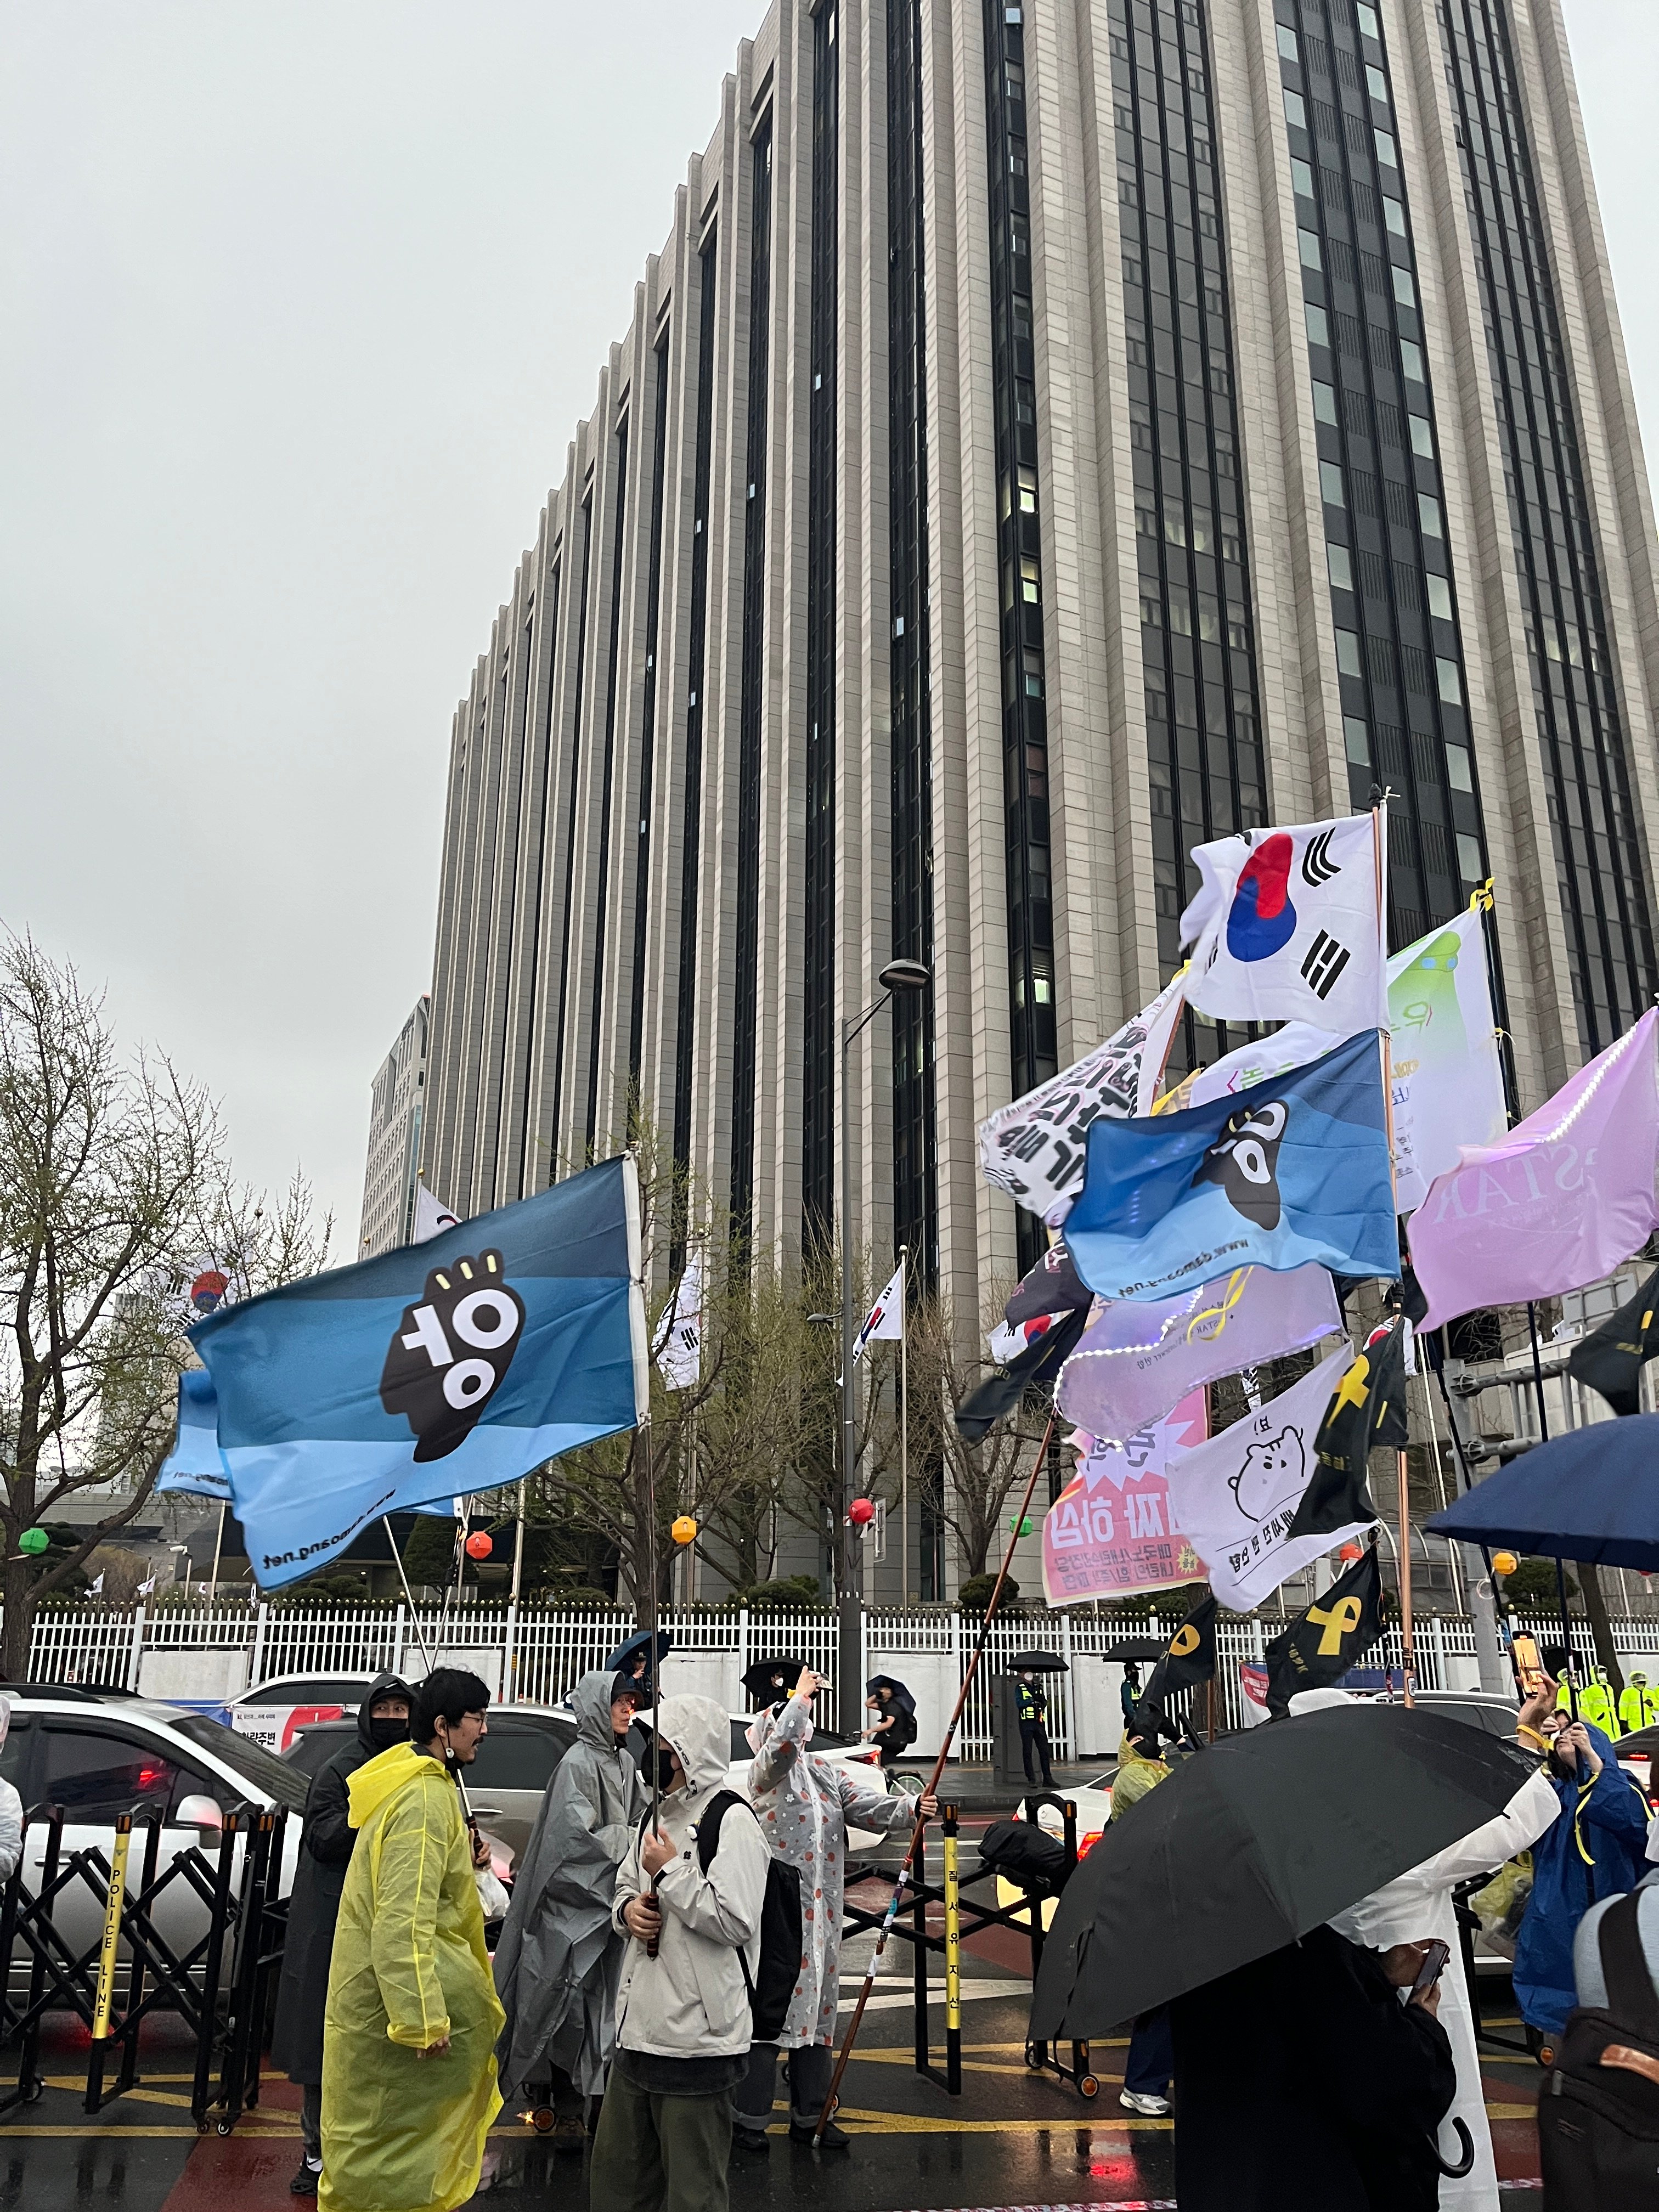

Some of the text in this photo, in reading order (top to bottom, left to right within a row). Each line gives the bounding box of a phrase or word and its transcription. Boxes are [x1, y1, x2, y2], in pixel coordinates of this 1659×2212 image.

[97, 1869, 121, 2018] POLICE LINE
[949, 1870, 959, 2009] 질서유지선
